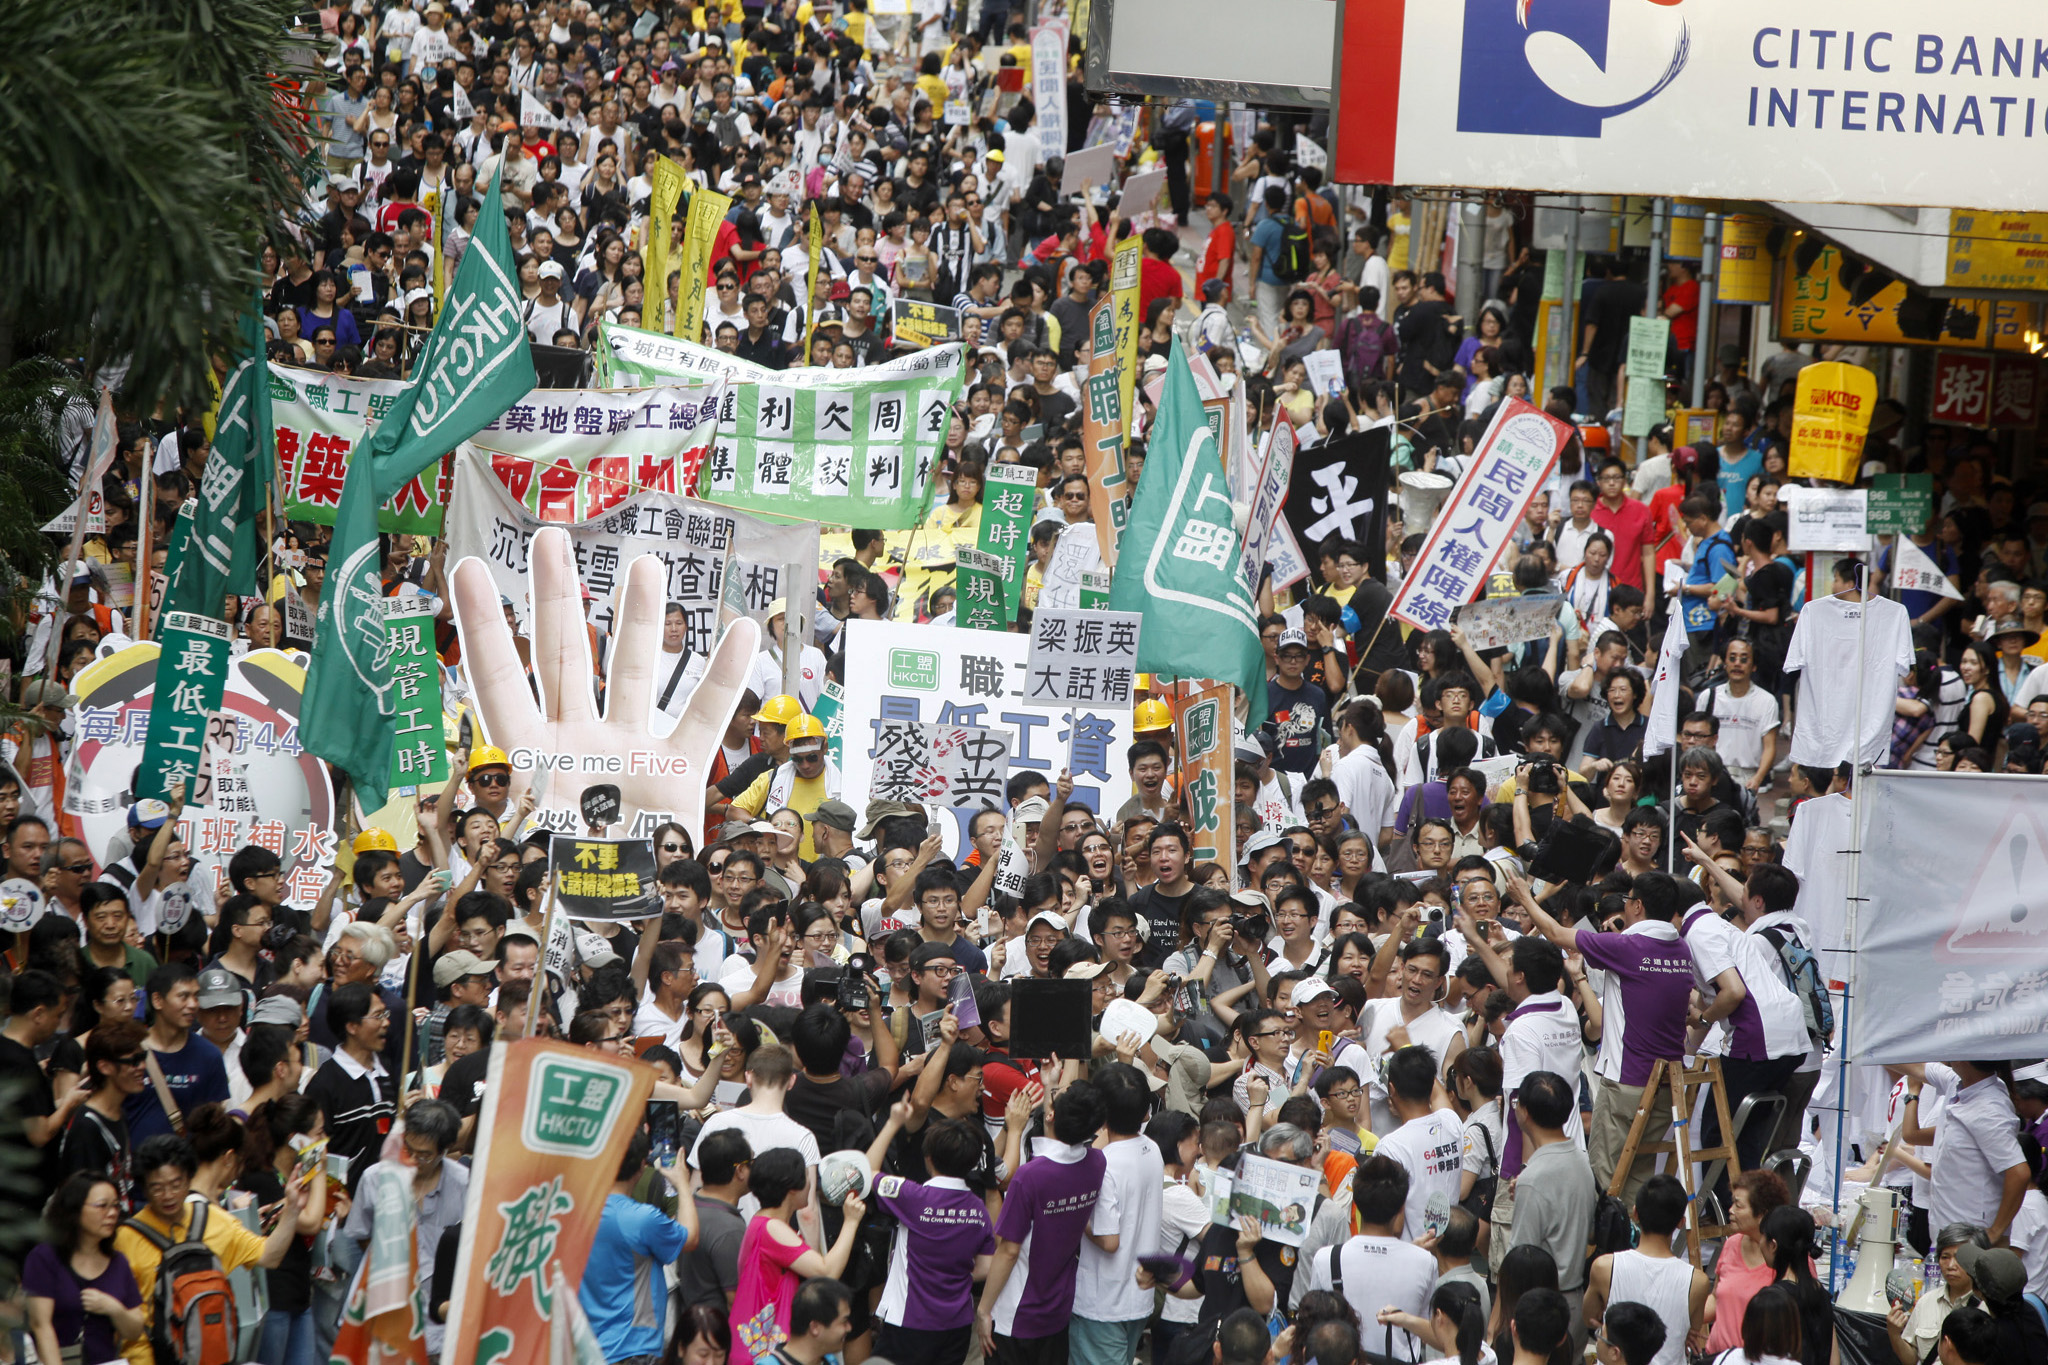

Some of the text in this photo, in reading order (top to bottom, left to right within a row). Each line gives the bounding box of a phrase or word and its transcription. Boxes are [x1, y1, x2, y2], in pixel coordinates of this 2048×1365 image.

[1752, 27, 1893, 73] CITIC
[1748, 86, 2048, 138] INTERNATI
[1115, 252, 1137, 279] 街工
[1827, 390, 1862, 411] KMB
[1936, 365, 1985, 415] 粥
[1497, 439, 1543, 472] 請支持
[1005, 467, 1035, 483] 職工盟
[1304, 460, 1374, 543] 平
[1869, 491, 1888, 501] 961
[1868, 510, 1891, 521] 968
[1406, 458, 1527, 631] 民間人權陣線
[973, 552, 1001, 572] 職工盟
[288, 606, 308, 622] 取消
[391, 597, 432, 614] 職工盟
[188, 616, 228, 637] 職工盟
[1038, 618, 1137, 656] 梁振英
[1281, 630, 1306, 642] BLACK
[896, 653, 933, 671] 工盟
[893, 671, 935, 685] HKCTU
[1031, 664, 1131, 702] 大話精
[386, 624, 437, 777] 規管工時
[158, 639, 216, 794] 最低工資
[1190, 707, 1212, 734] 工盟
[511, 749, 687, 775] Give me Five
[952, 731, 1005, 808] 中共
[218, 778, 248, 793] 取消
[575, 842, 619, 870] 不要
[551, 929, 568, 950] 消
[1650, 966, 1661, 974] Civic
[548, 1073, 613, 1112] 工盟
[540, 1110, 600, 1140] HKCTU
[920, 1215, 930, 1223] The
[944, 1218, 956, 1226] Way,
[1054, 1206, 1065, 1214] Civic
